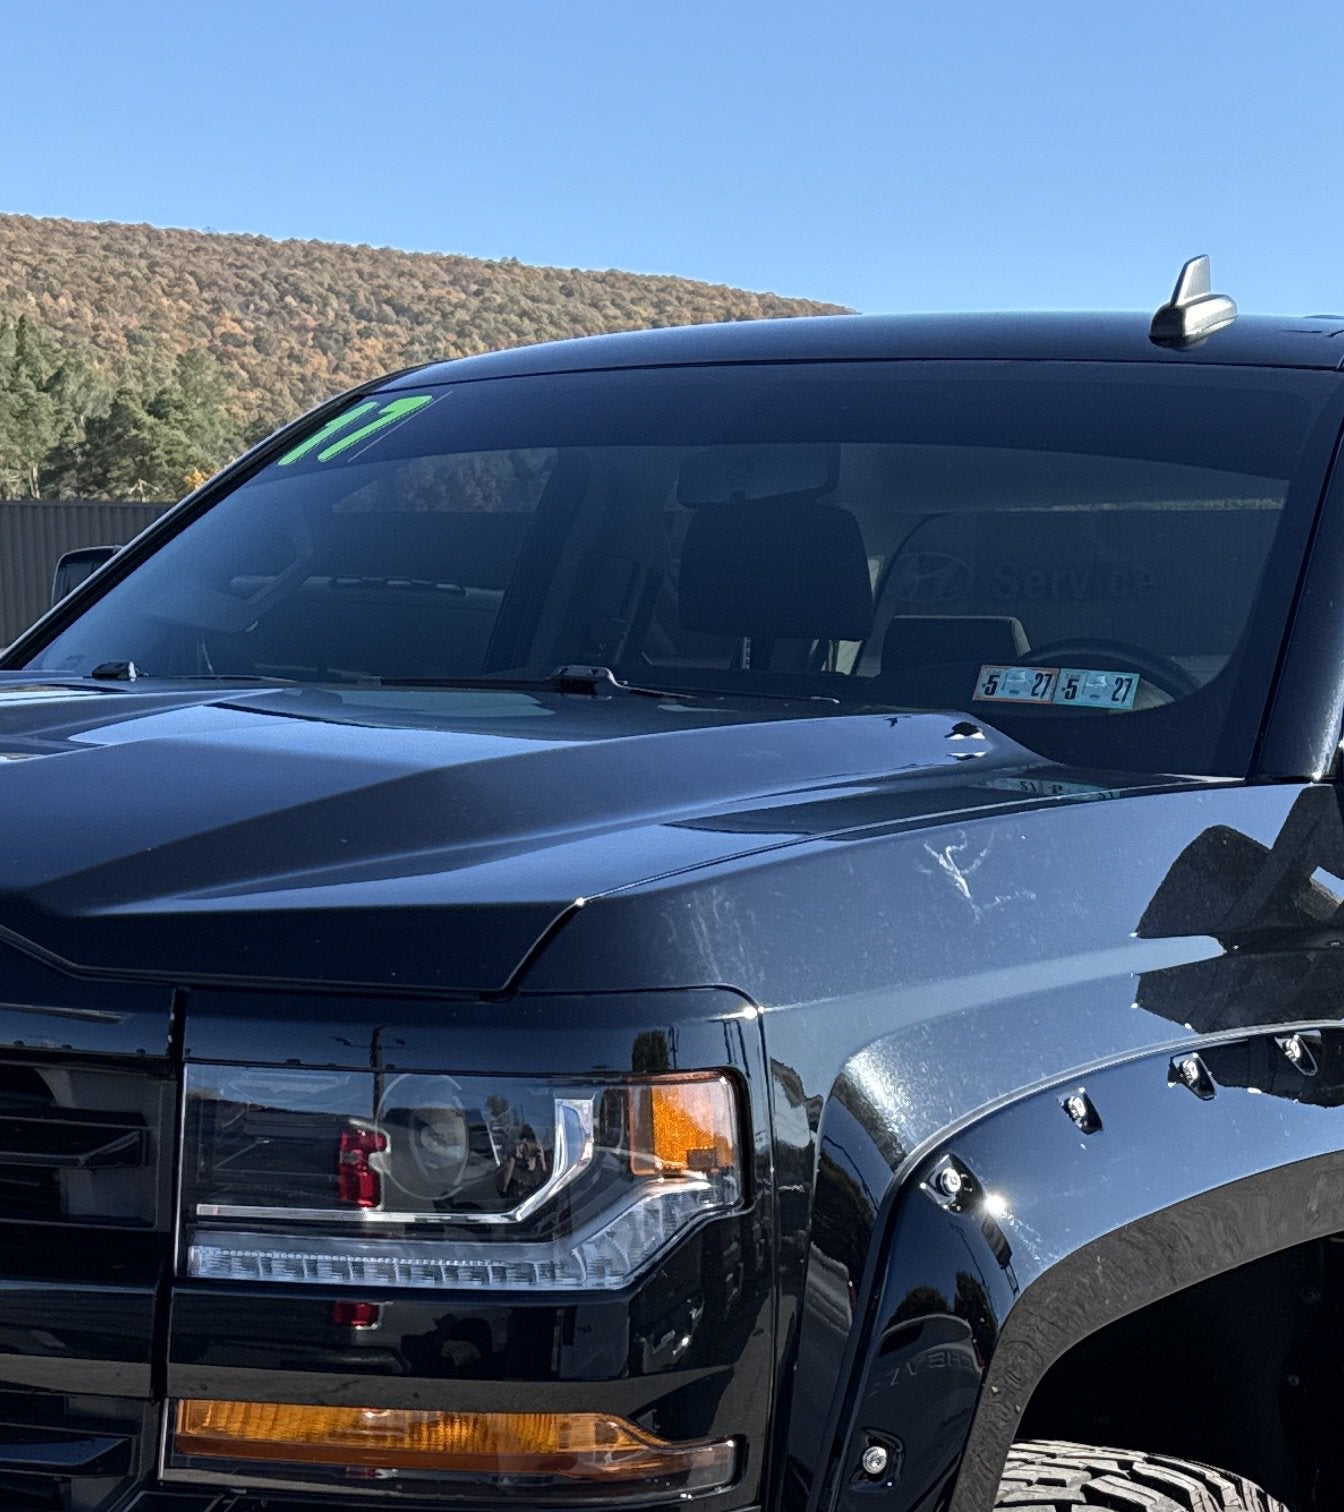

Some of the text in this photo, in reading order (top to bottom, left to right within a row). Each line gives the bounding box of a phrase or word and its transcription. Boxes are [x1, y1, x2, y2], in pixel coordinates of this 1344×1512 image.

[277, 395, 433, 466] 17
[1030, 672, 1054, 699] 27
[1110, 676, 1134, 704] 27
